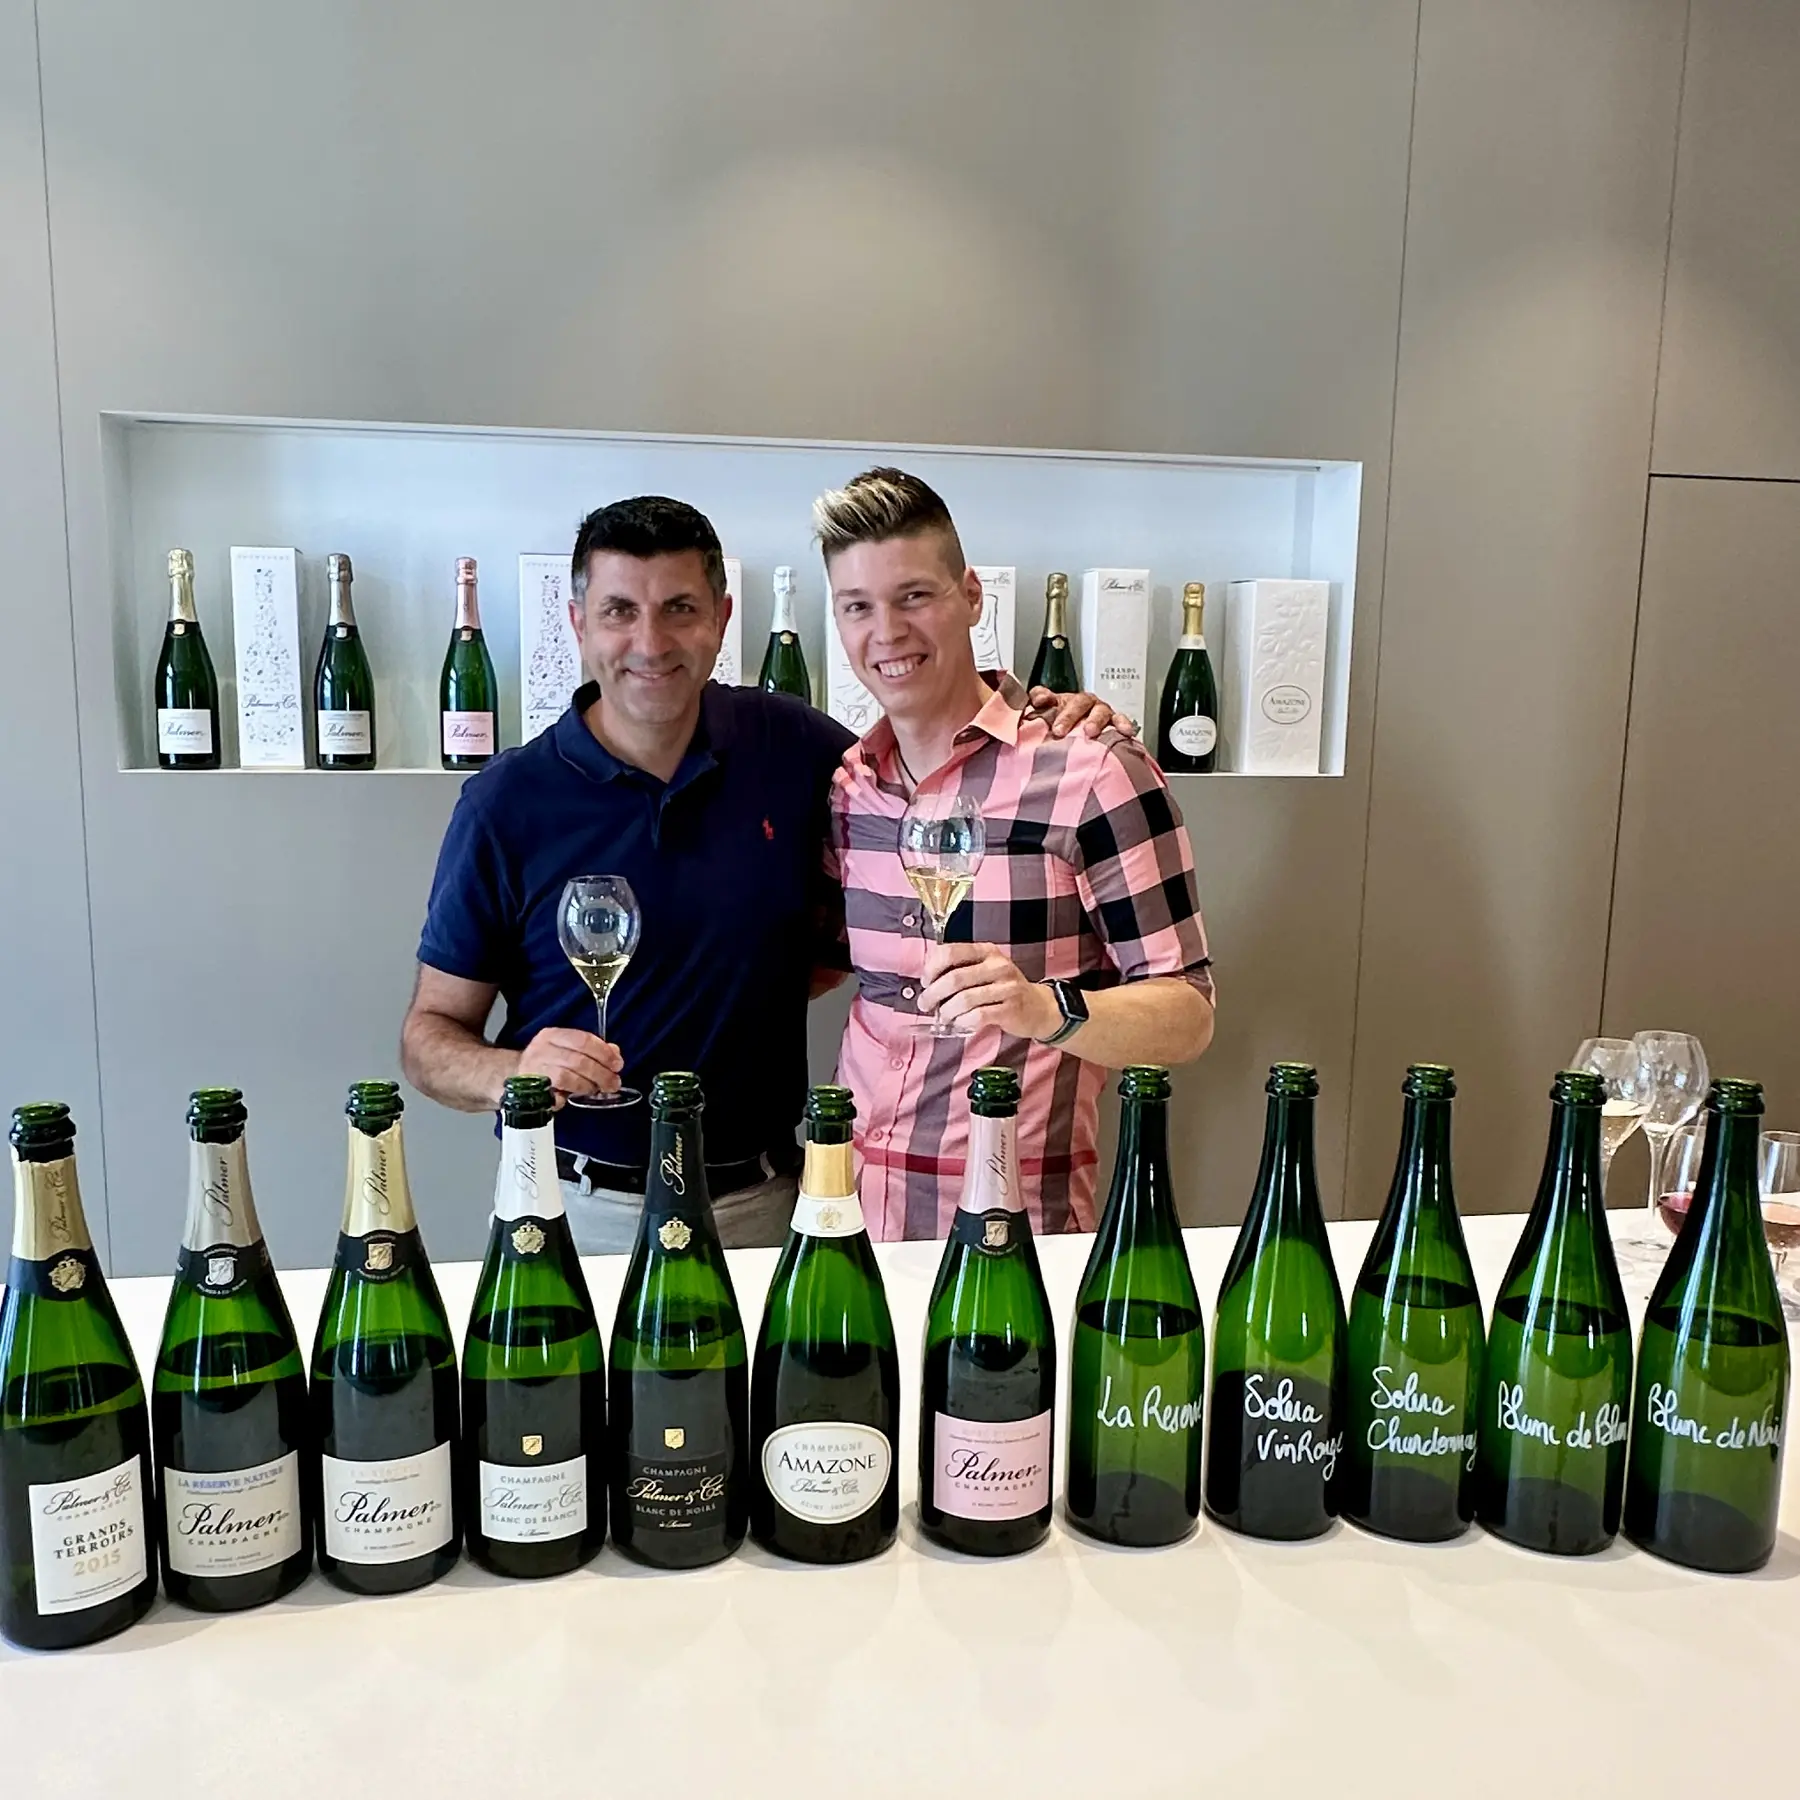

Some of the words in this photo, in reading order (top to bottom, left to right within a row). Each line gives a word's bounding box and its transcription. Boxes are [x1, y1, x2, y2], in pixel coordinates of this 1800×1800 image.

[513, 1139, 540, 1199] Palmer
[660, 1132, 685, 1195] Palmer
[983, 1130, 1008, 1195] Palmer
[202, 1156, 233, 1227] Palmer
[362, 1146, 391, 1215] Palmer
[1097, 1375, 1134, 1429] La
[1498, 1380, 1561, 1445] Blanc
[1566, 1411, 1592, 1449] de
[1647, 1382, 1711, 1444] Blanc
[1716, 1416, 1744, 1449] de
[778, 1450, 878, 1474] AMAZONE
[793, 1441, 864, 1453] CHAMPAGNE
[500, 1472, 566, 1485] CHAMPAGNE
[643, 1465, 708, 1477] CHAMPAGNE
[945, 1449, 1038, 1482] Palmer
[483, 1487, 542, 1510] Palmer
[626, 1477, 684, 1502] Palmer
[955, 1480, 1034, 1492] CHAMPAGNE
[43, 1488, 101, 1516] Palmer
[334, 1491, 435, 1523] Palmer
[490, 1514, 521, 1525] BLANC
[525, 1517, 538, 1525] DE
[542, 1509, 578, 1523] BLANCS
[635, 1503, 666, 1516] BLANC
[669, 1508, 682, 1517] DE
[686, 1502, 717, 1516] NOIRS
[63, 1517, 127, 1547] GRANDS
[177, 1503, 282, 1536] Palmer
[344, 1516, 432, 1534] CHAMPAGNE
[53, 1523, 135, 1560] TERROIRS
[188, 1526, 279, 1546] CHAMPAGNE
[73, 1547, 122, 1577] 2015
